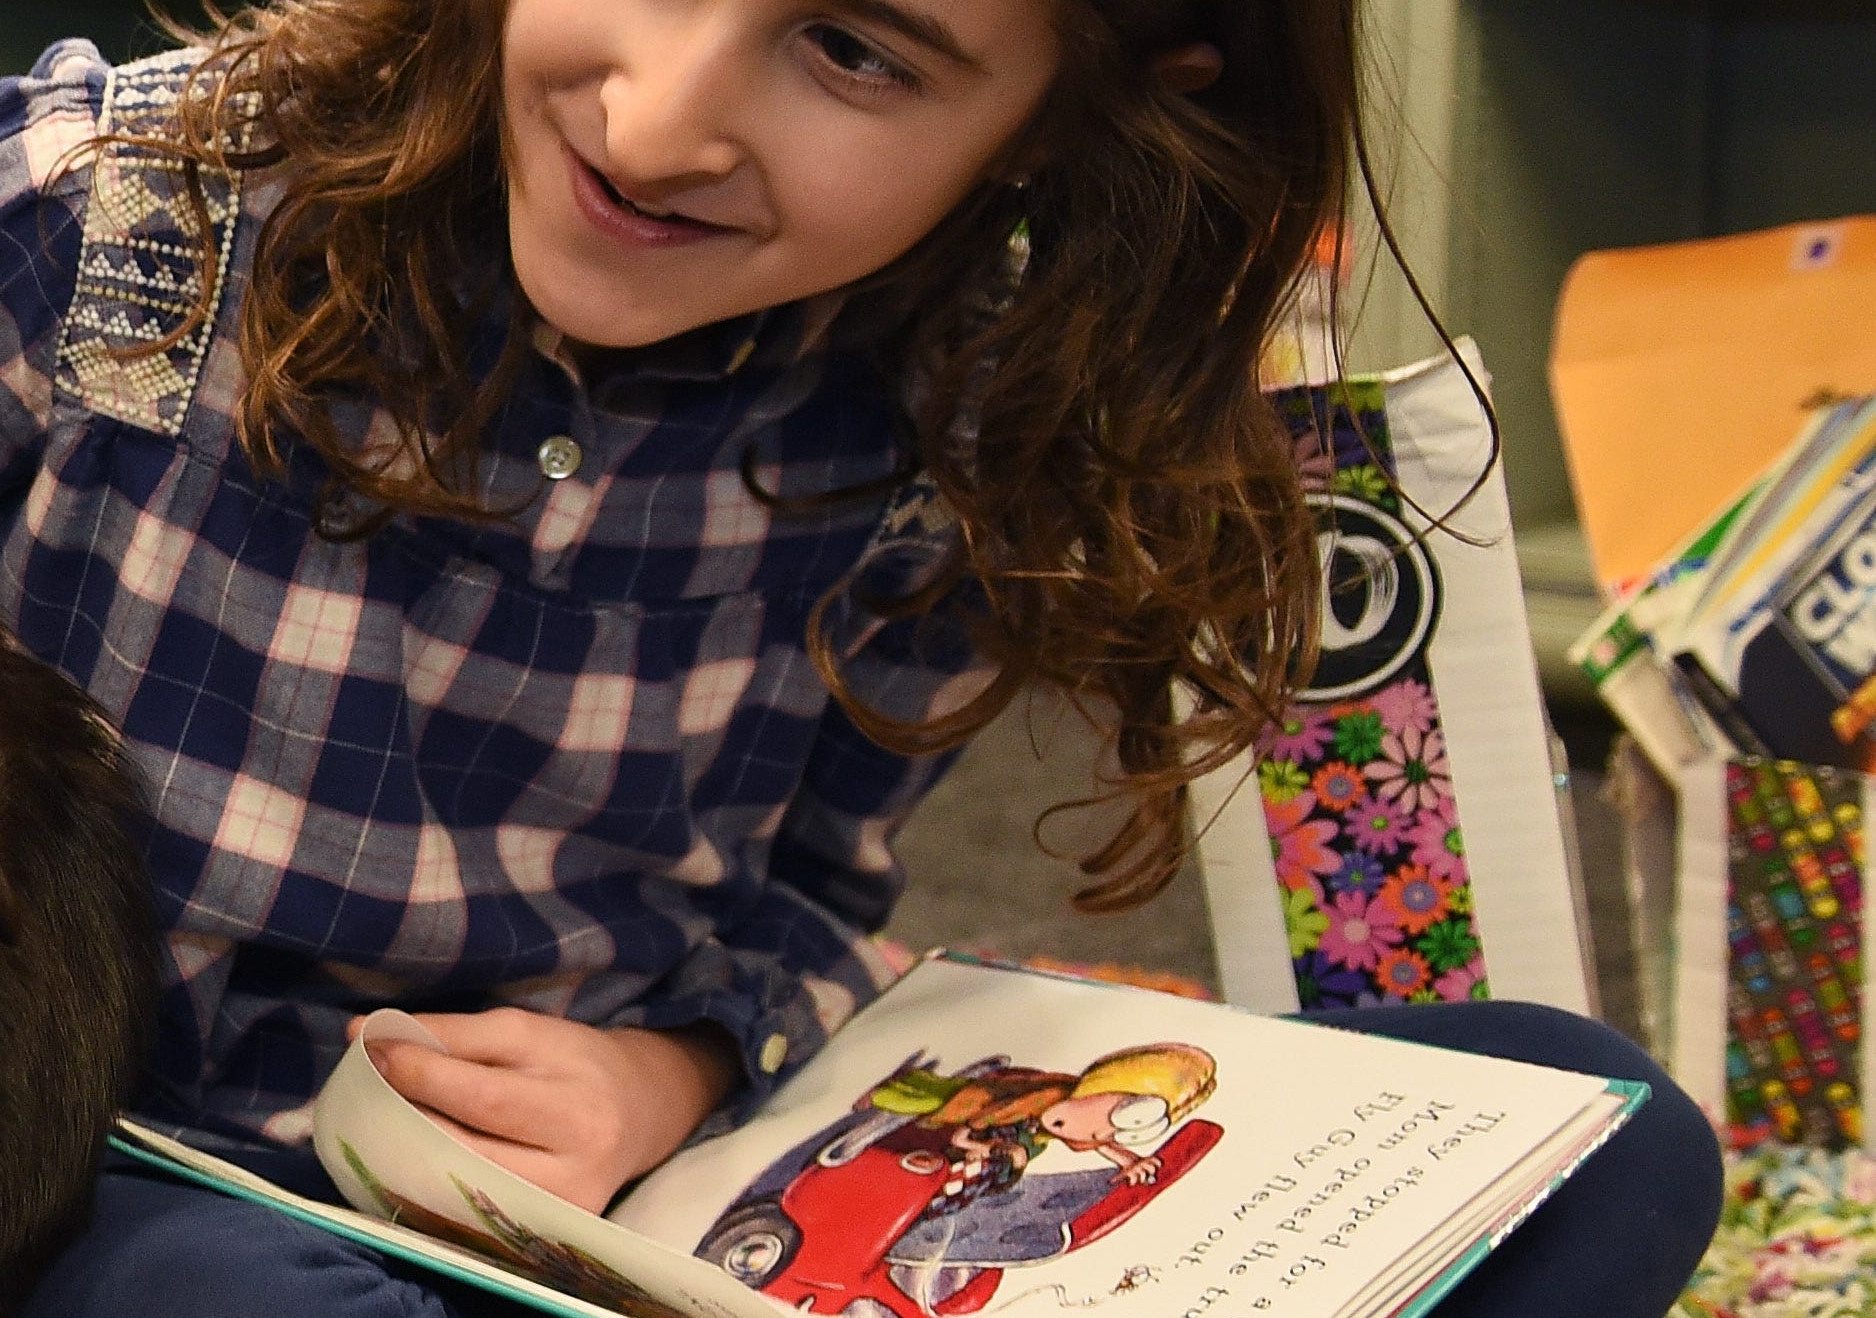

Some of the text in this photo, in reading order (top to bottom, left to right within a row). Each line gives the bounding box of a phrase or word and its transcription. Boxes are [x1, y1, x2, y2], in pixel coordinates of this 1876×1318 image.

[1377, 1099, 1456, 1152] Mom
[1427, 1110, 1508, 1162] They
[1174, 1091, 1406, 1269] Fly Guy flew out.
[1277, 1156, 1371, 1237] opened
[1321, 1165, 1425, 1251] stopped
[1228, 1237, 1280, 1278] the
[1278, 1254, 1327, 1291] for
[1251, 1294, 1273, 1312] a
